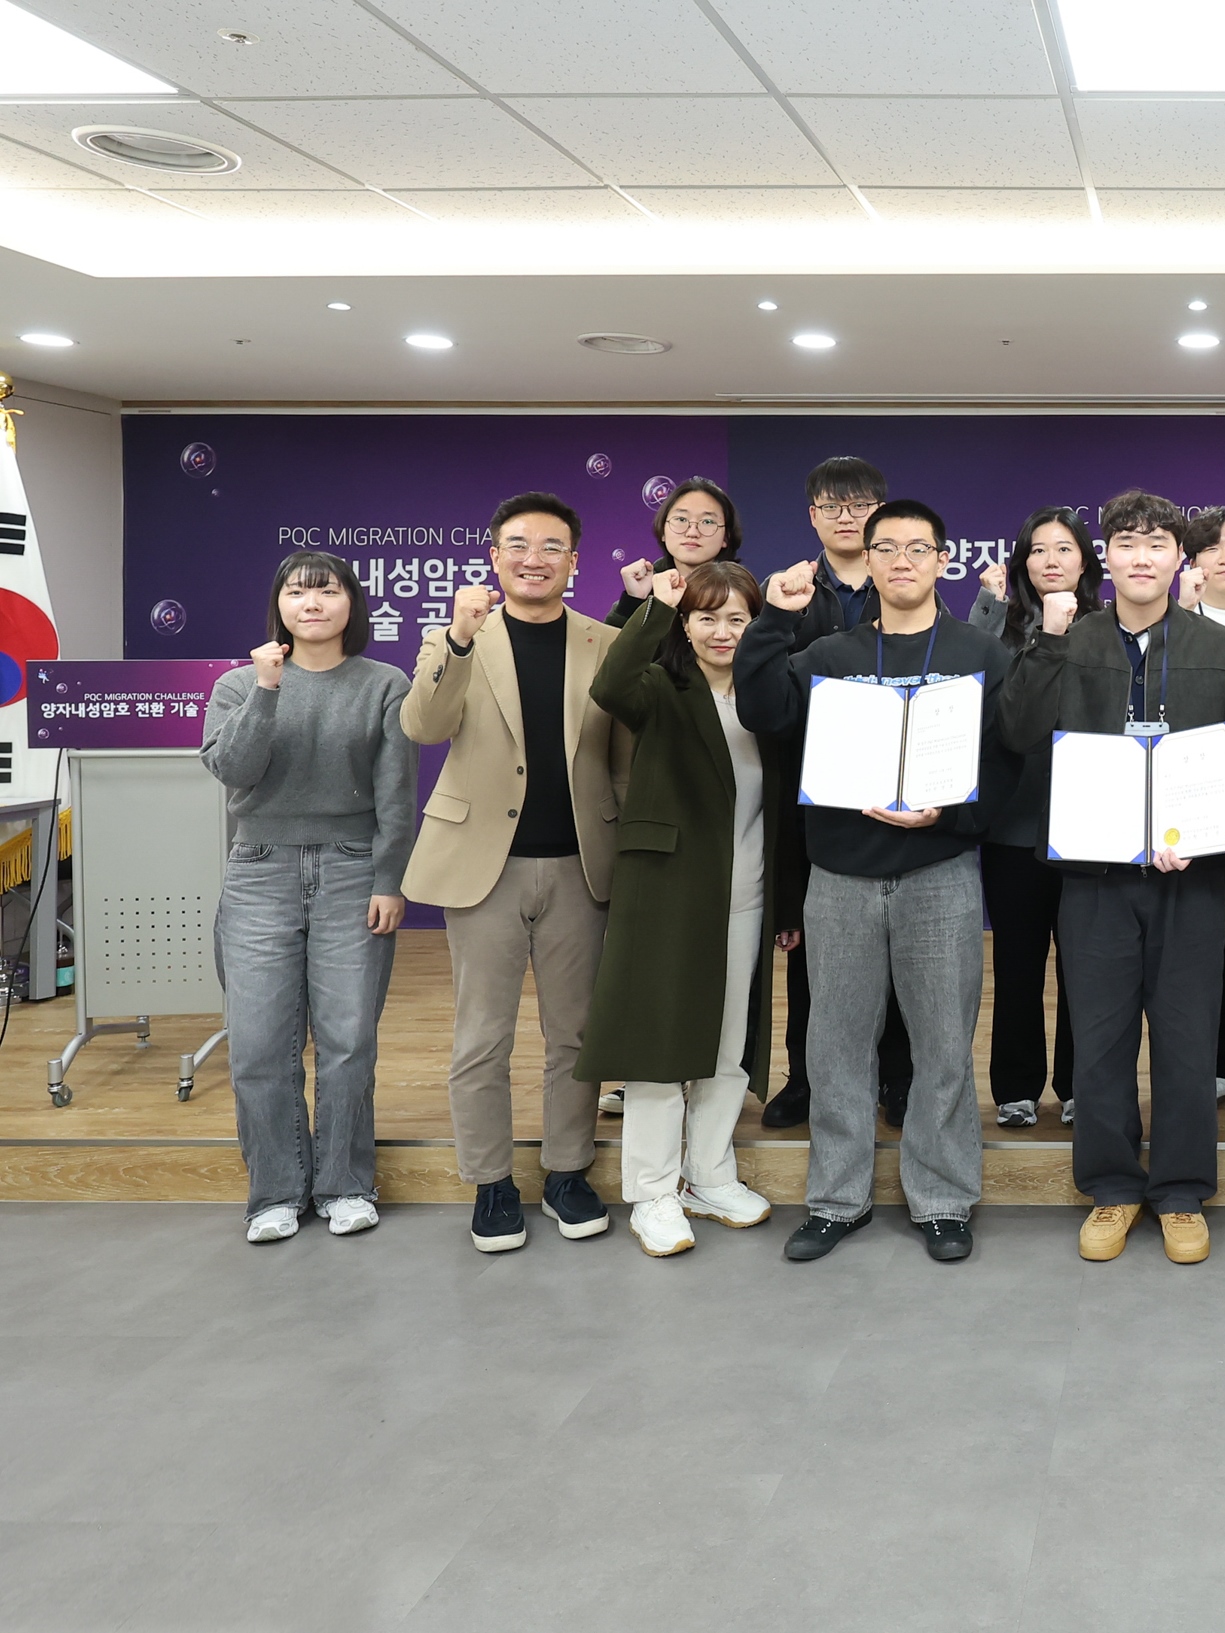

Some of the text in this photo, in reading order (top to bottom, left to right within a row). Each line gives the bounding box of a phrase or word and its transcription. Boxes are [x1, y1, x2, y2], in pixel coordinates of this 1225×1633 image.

[278, 526, 321, 552] PQC
[328, 526, 443, 546] MIGRATION
[84, 693, 102, 702] PQC
[154, 692, 205, 700] CHALLENGE
[41, 702, 131, 719] 양자내성암호
[135, 702, 165, 718] 전환
[170, 702, 199, 718] 기술
